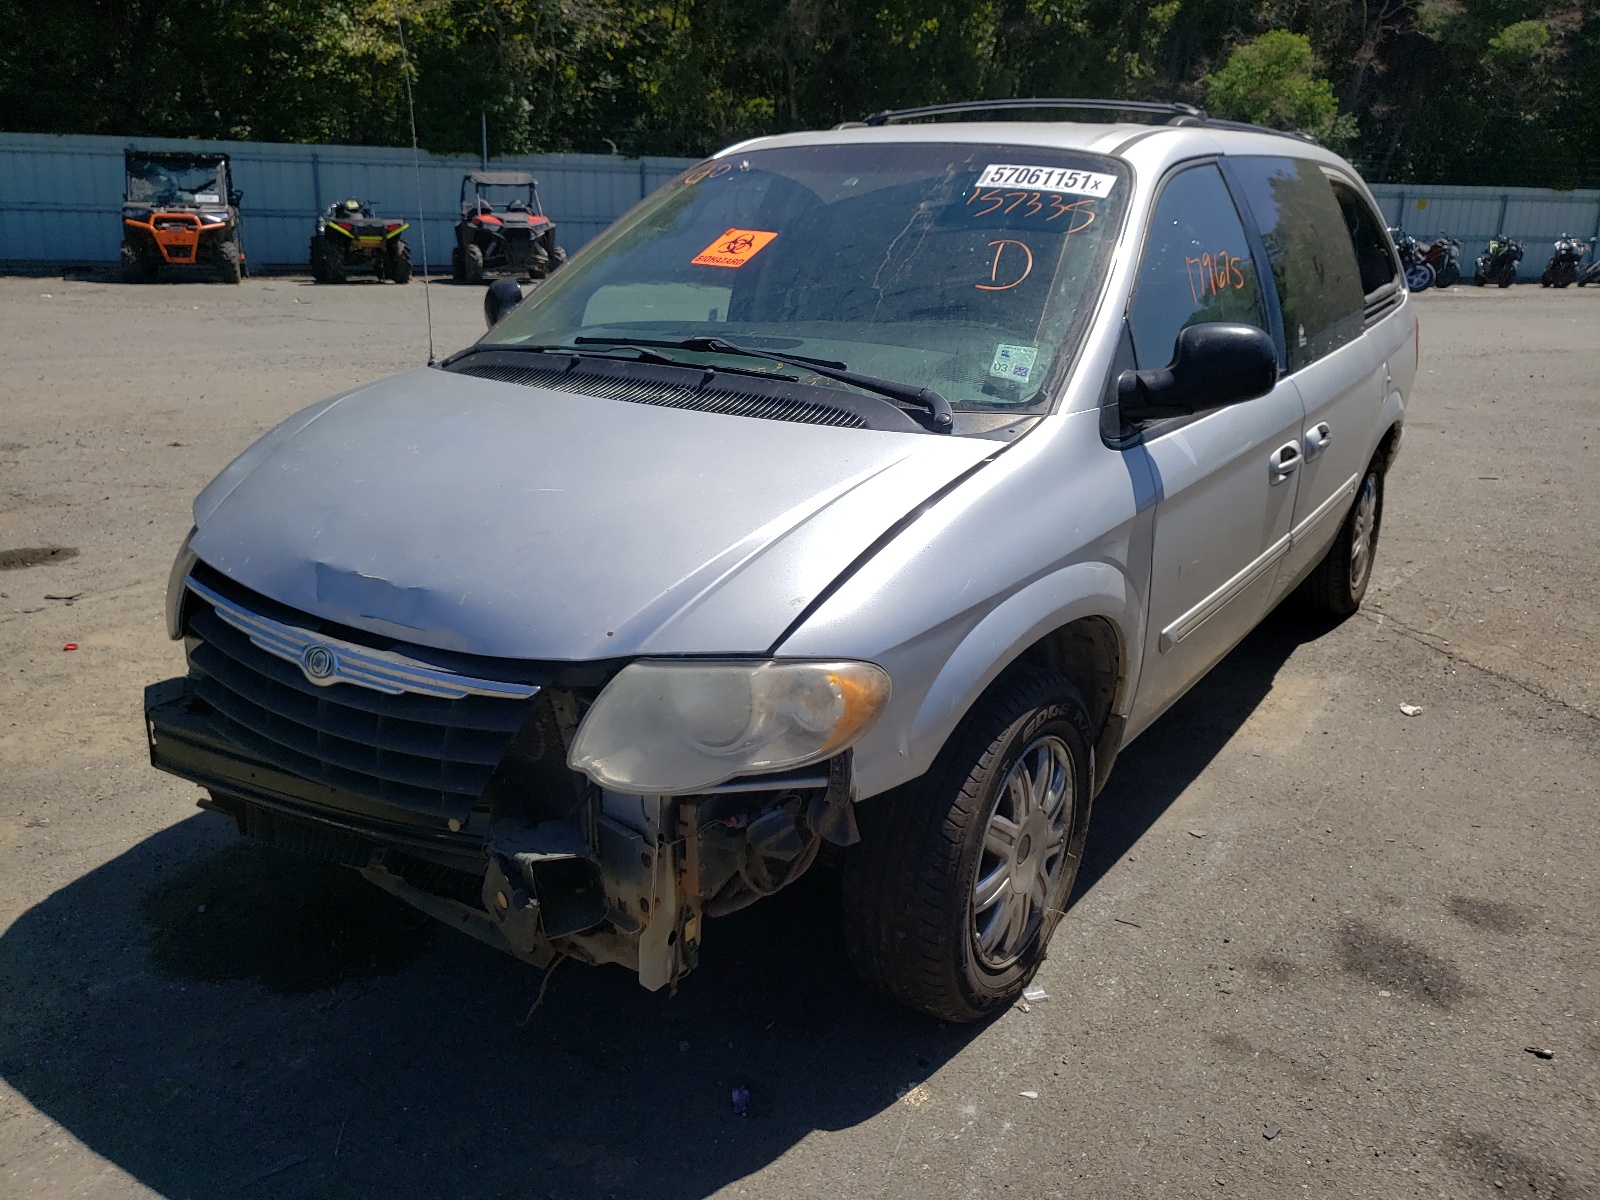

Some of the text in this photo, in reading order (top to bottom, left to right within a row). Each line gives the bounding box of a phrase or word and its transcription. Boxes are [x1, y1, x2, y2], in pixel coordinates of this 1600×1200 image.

[694, 255, 745, 265] BIOHAZARD
[975, 239, 1033, 290] D
[994, 361, 1008, 373] 03
